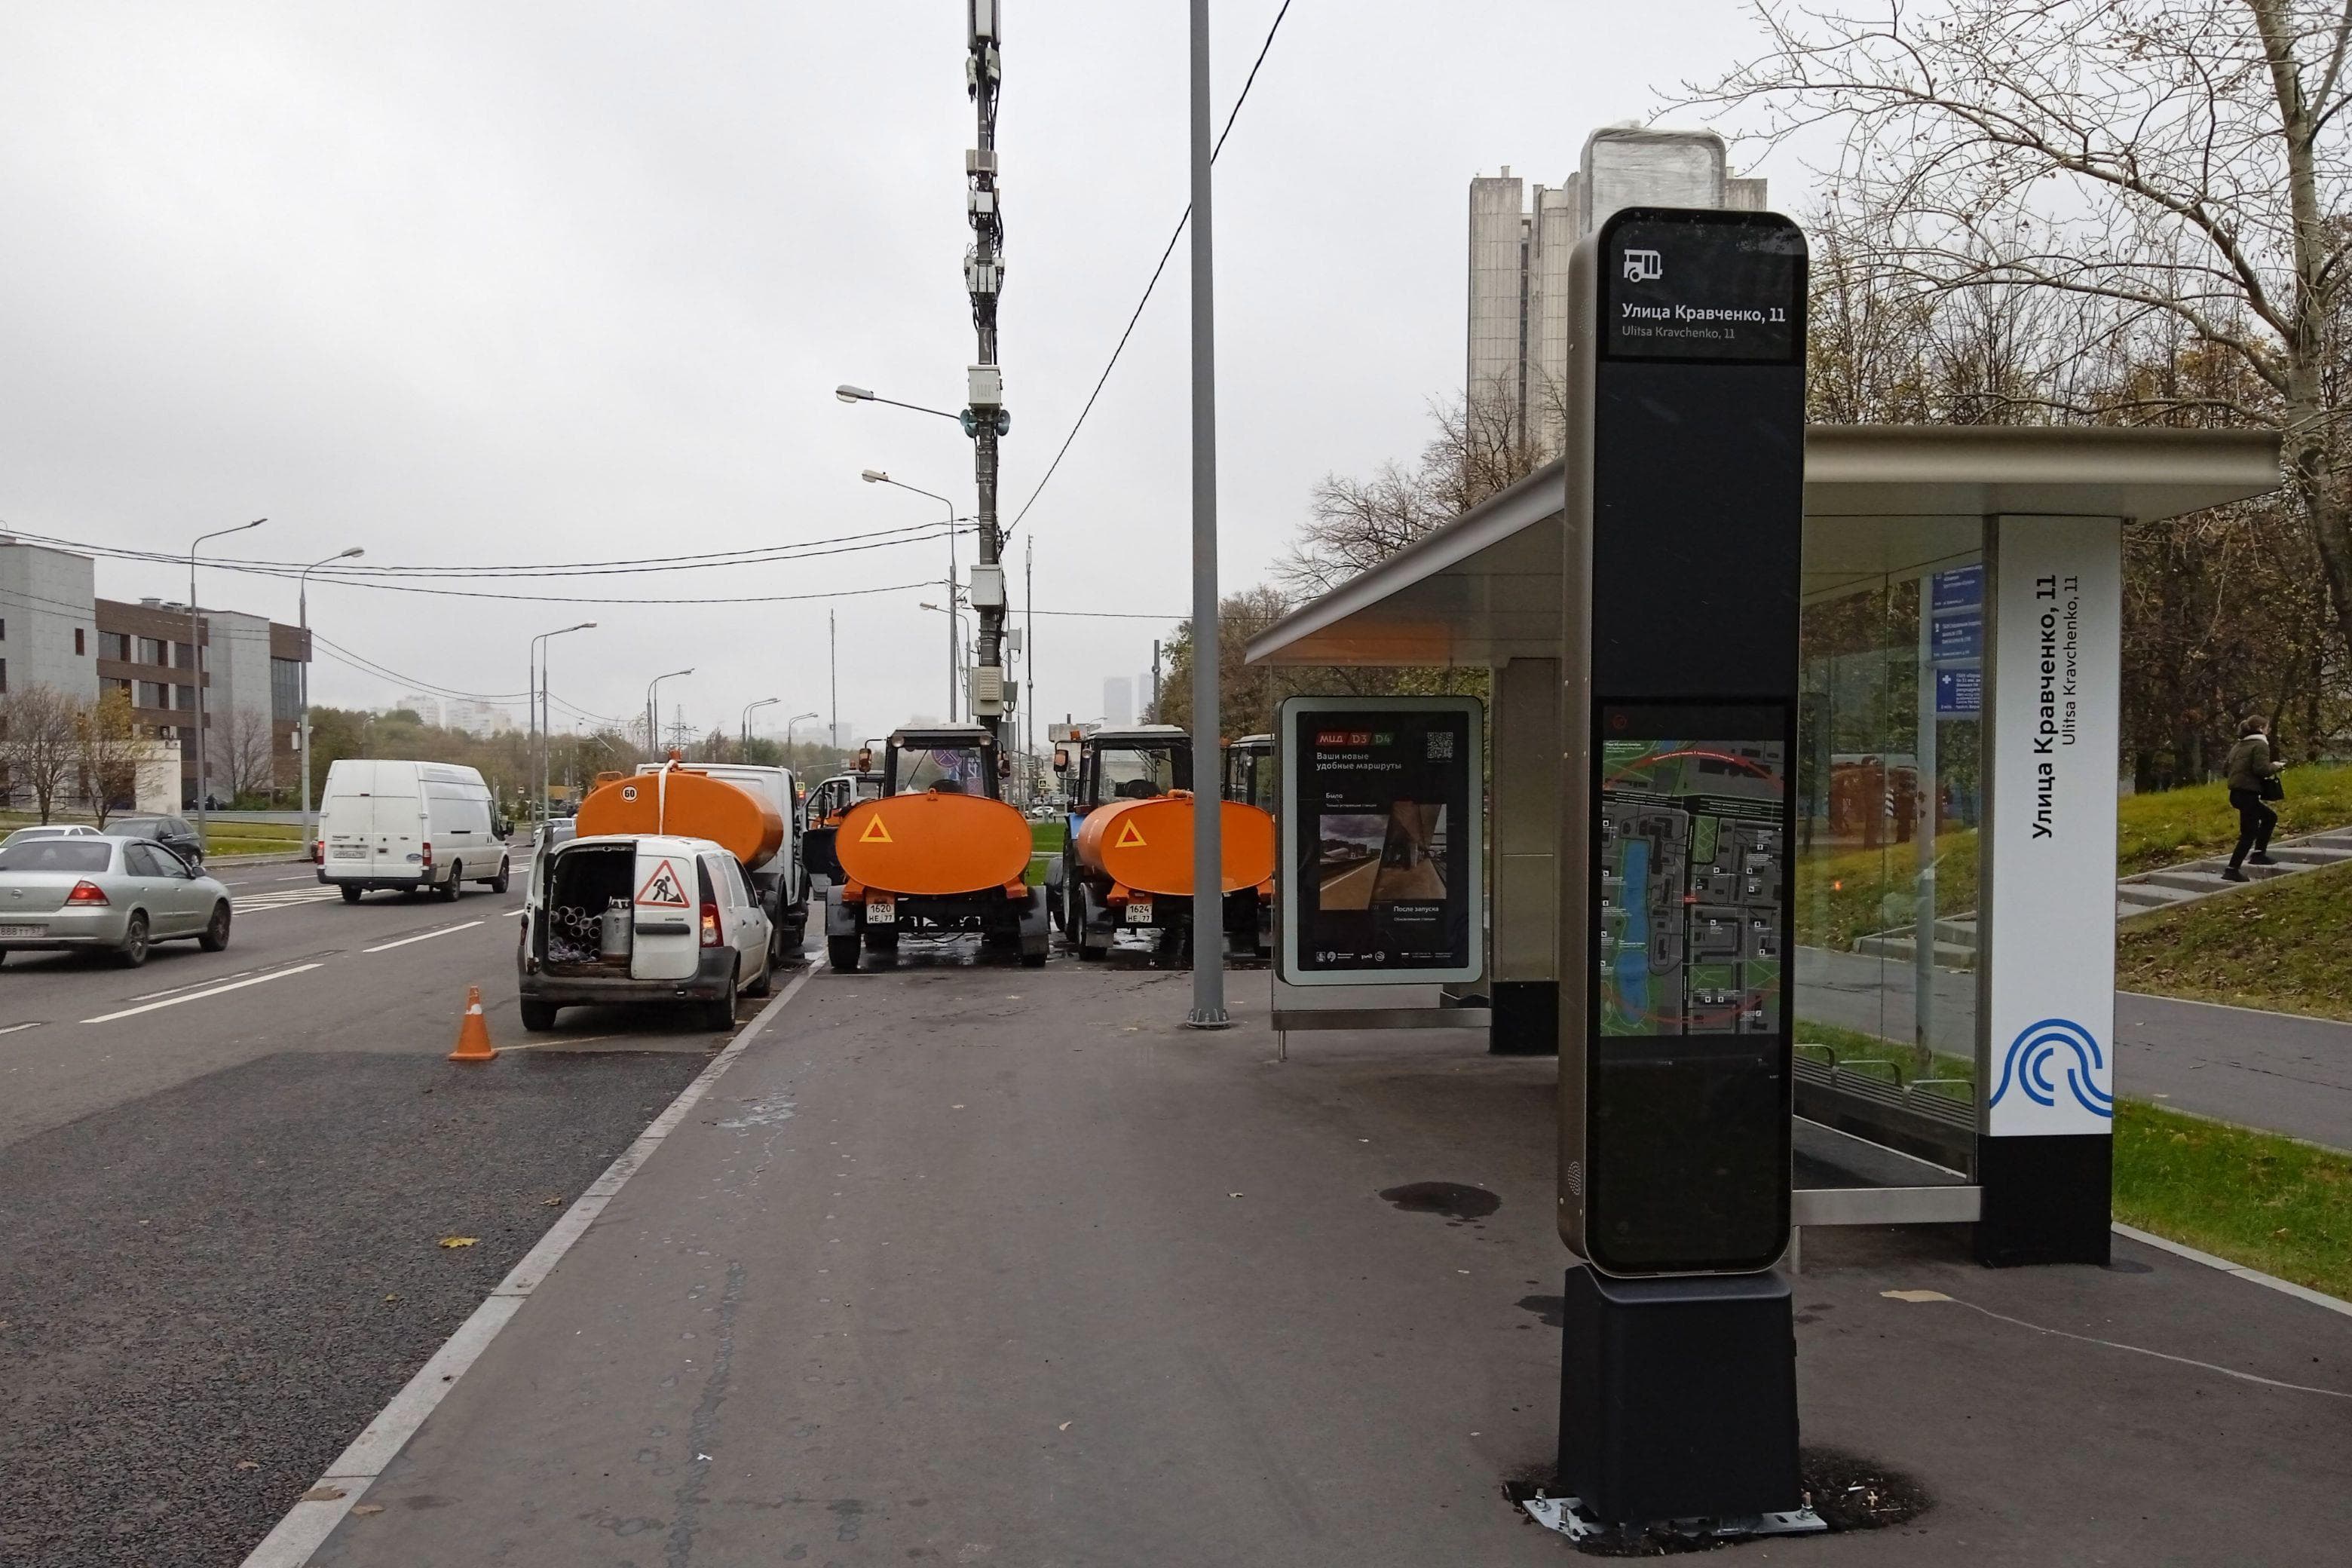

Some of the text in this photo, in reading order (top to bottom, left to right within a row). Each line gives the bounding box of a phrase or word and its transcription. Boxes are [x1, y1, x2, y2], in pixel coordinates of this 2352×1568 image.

[1622, 303, 1786, 324] Улица Кравченко, 11
[1622, 326, 1735, 339] Ulitsa Kravchenko, 11
[2062, 575, 2079, 745] Ulitsa Kravchenko, 11
[2032, 574, 2060, 839] Улица Кравченко, 11
[1352, 734, 1367, 743] D3
[1376, 734, 1390, 743] D4
[1316, 762, 1402, 771] удобные маршруты
[624, 789, 635, 798] 60
[871, 905, 891, 913] 1620
